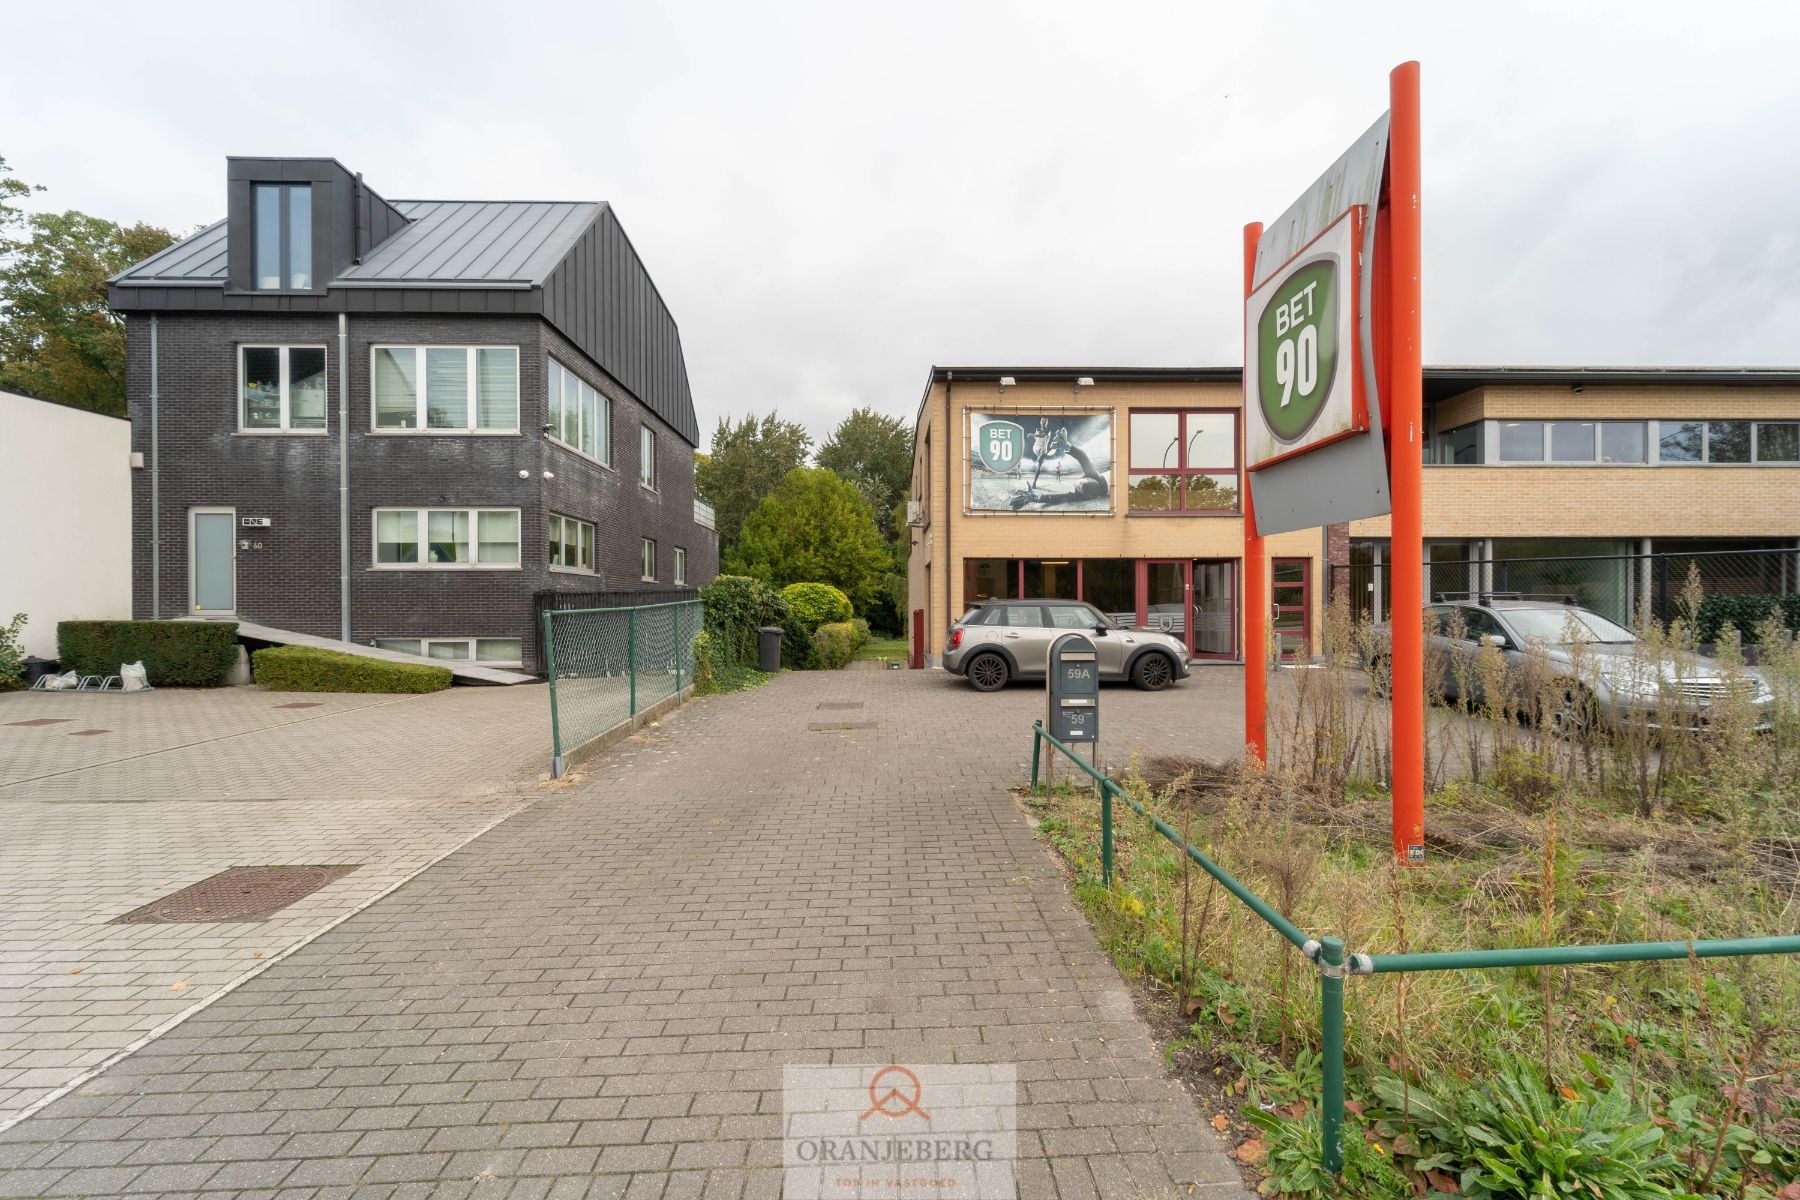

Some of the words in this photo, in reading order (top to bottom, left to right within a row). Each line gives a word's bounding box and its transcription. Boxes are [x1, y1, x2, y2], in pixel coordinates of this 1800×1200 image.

[1275, 280, 1317, 338] BET
[1276, 324, 1318, 408] 90
[990, 428, 1013, 439] BET
[990, 440, 1013, 461] 90
[1067, 668, 1091, 679] 59A
[1071, 714, 1085, 725] 59
